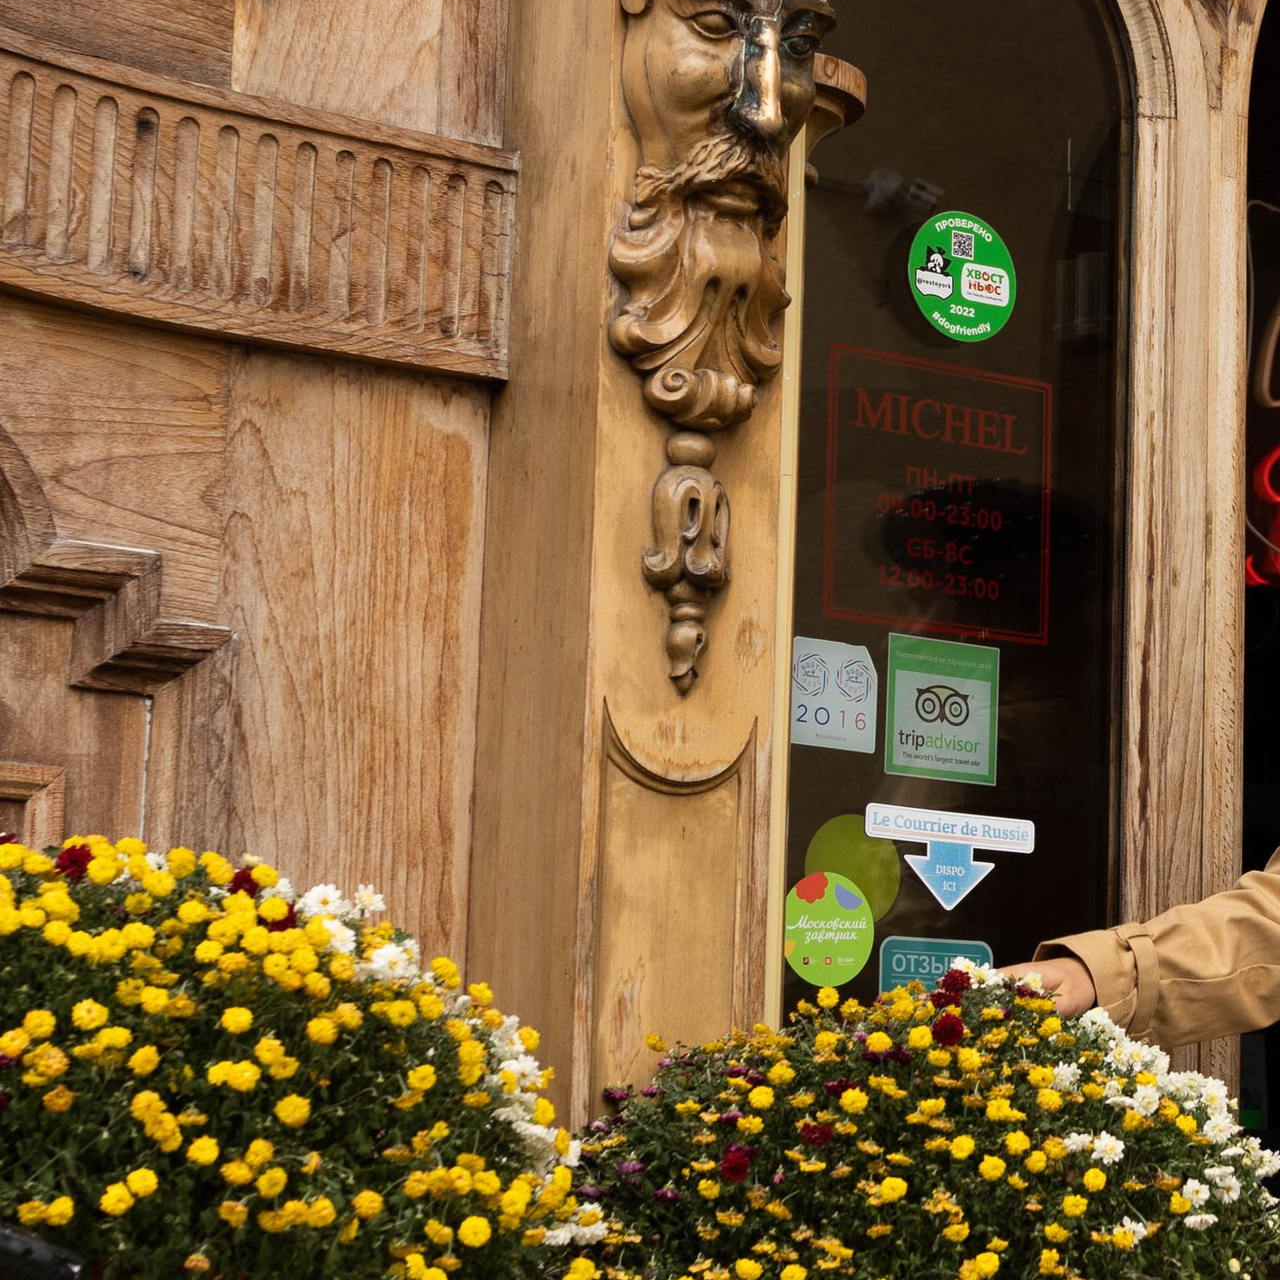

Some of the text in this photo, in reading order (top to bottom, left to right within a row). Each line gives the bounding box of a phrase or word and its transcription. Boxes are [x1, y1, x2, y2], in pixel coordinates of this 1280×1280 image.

[934, 217, 993, 243] ПРОВЕРЕНО
[966, 267, 1004, 284] ХВОСТ
[950, 304, 976, 318] 2022
[932, 311, 992, 336] #dogfriendly
[853, 387, 1029, 455] MICHEL
[906, 465, 977, 495] ПН-ПТ
[876, 492, 1003, 531] 09:00-23:00
[906, 537, 973, 565] СБ-ВС
[877, 564, 1000, 600] 12:00-23:00
[796, 704, 867, 731] 2016
[898, 729, 980, 753] tripadvisor
[902, 751, 980, 767] The world's largest travel site
[872, 812, 1029, 841] Le Courrier de Russie
[935, 865, 965, 877] DISPO
[943, 881, 956, 891] ICI
[787, 915, 868, 930] Московский
[804, 931, 859, 944] завтрак
[892, 954, 981, 974] ОТЗЫ
